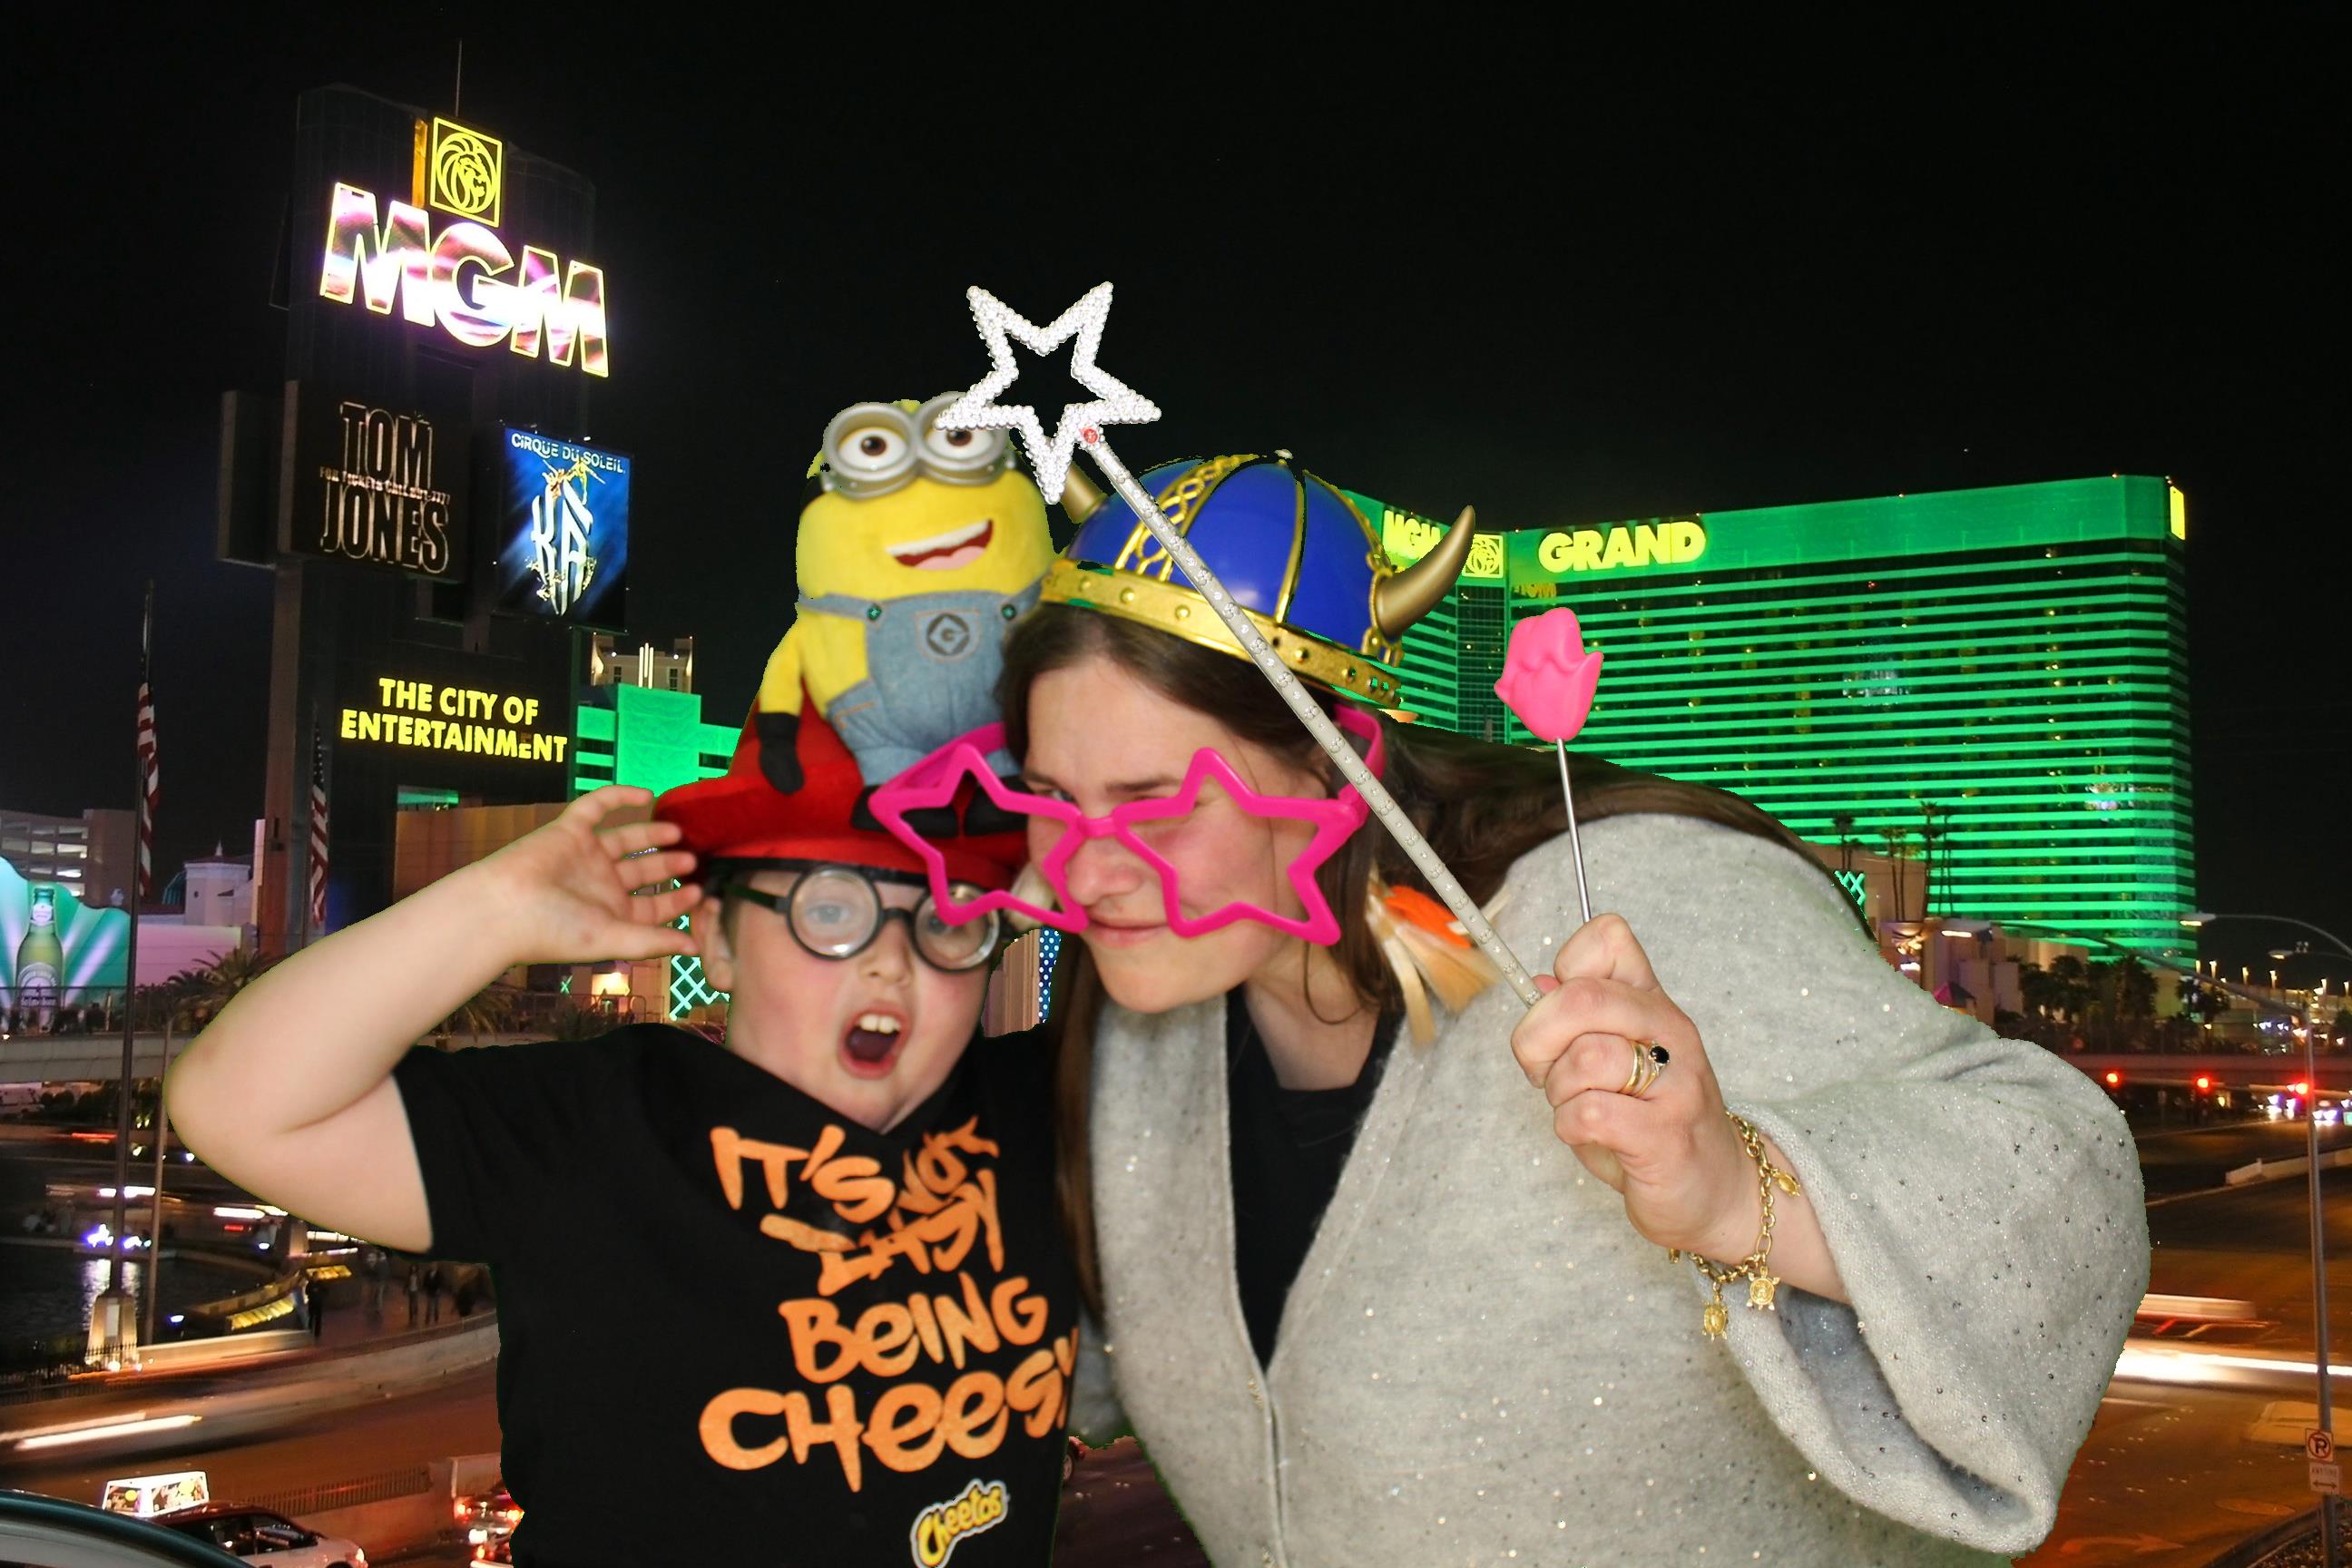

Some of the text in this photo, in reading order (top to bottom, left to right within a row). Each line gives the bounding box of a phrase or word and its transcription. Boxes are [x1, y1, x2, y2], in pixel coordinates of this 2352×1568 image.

[319, 181, 609, 377] MGM
[339, 401, 434, 490] TOM
[319, 480, 449, 573] JONES
[1538, 521, 1707, 573] GRAND
[341, 709, 568, 763] ENTERTAINMENT
[379, 678, 539, 725] THE CITY OF
[710, 1125, 896, 1223] IT'S
